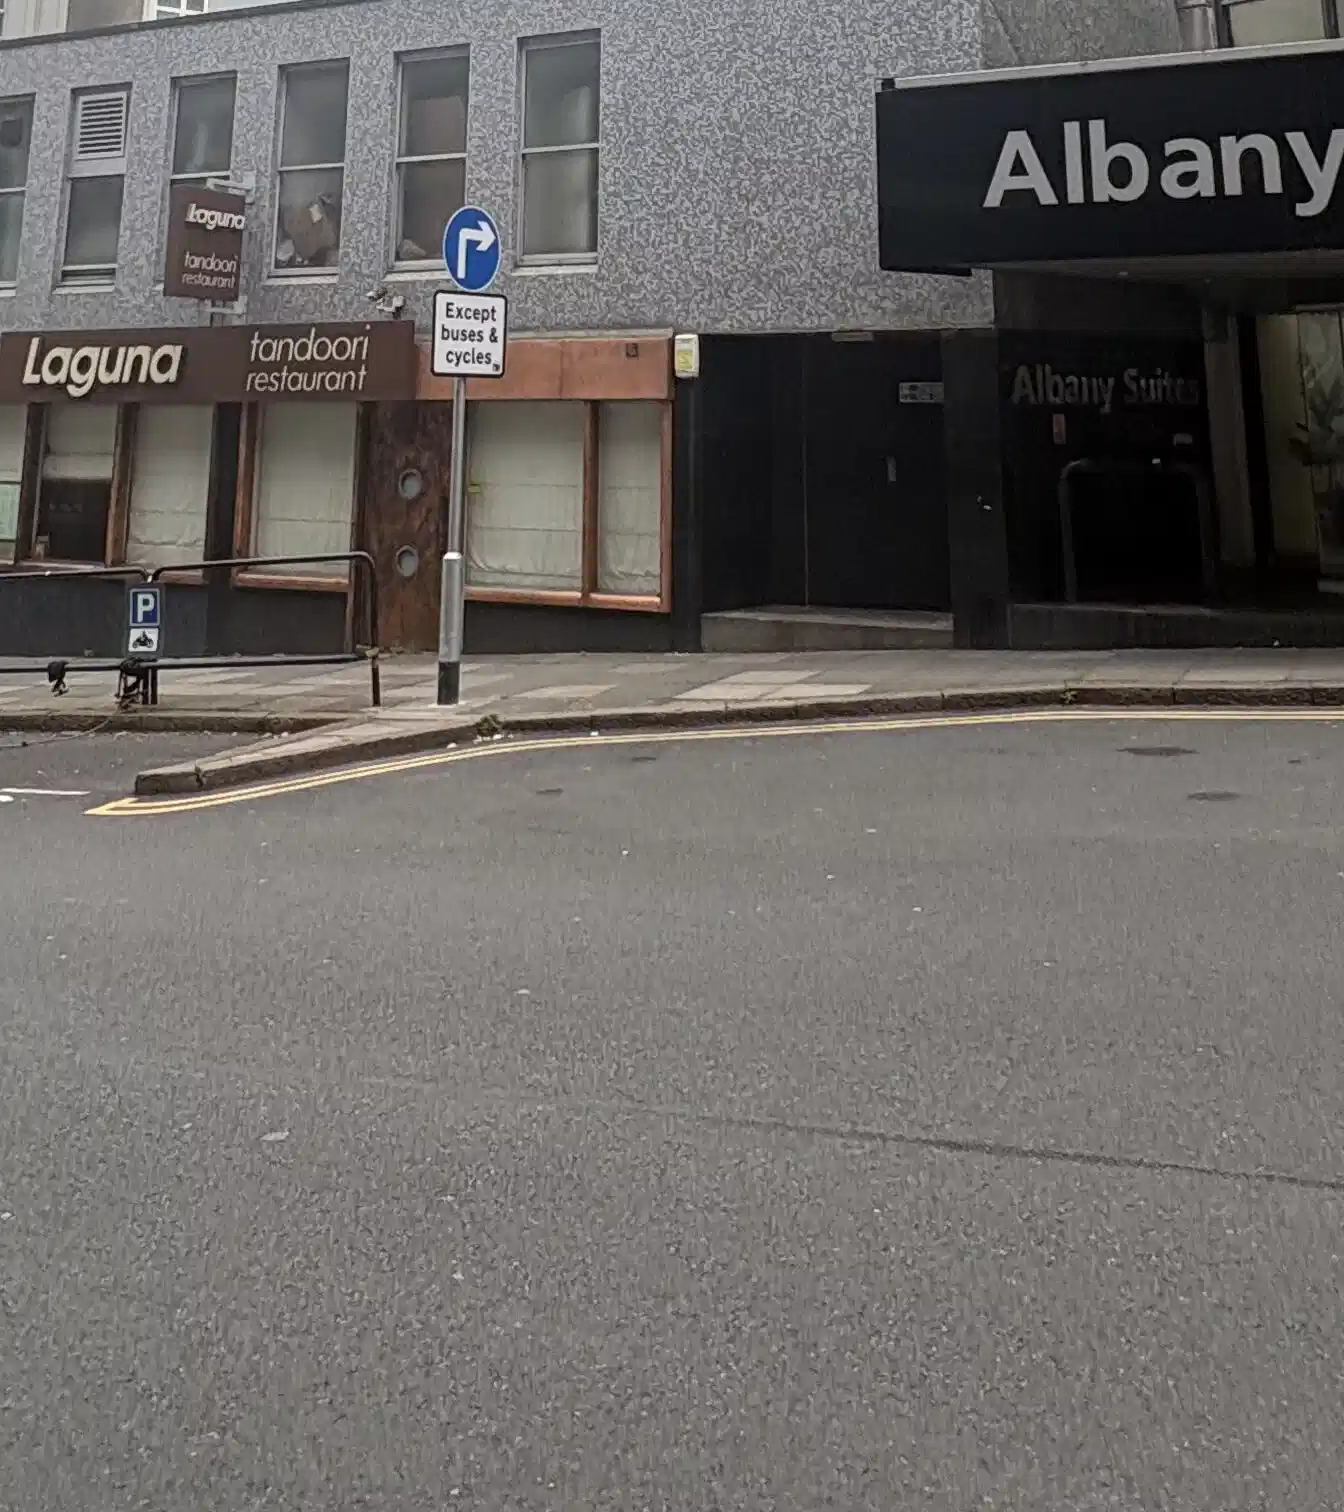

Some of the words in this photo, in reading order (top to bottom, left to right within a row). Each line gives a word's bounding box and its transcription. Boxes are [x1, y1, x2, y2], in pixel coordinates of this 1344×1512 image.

[185, 203, 246, 230] Laguna
[184, 251, 238, 272] tandoori
[181, 273, 236, 289] restaurant
[445, 301, 497, 324] Except
[250, 324, 371, 362] tandoori
[441, 324, 484, 343] buses
[489, 326, 498, 343] &
[22, 336, 184, 398] Laguna
[445, 348, 492, 367] cycles
[246, 365, 367, 392] restaurant
[1012, 363, 1115, 413] Albany
[1124, 367, 1200, 404] Suites
[137, 593, 155, 623] P
